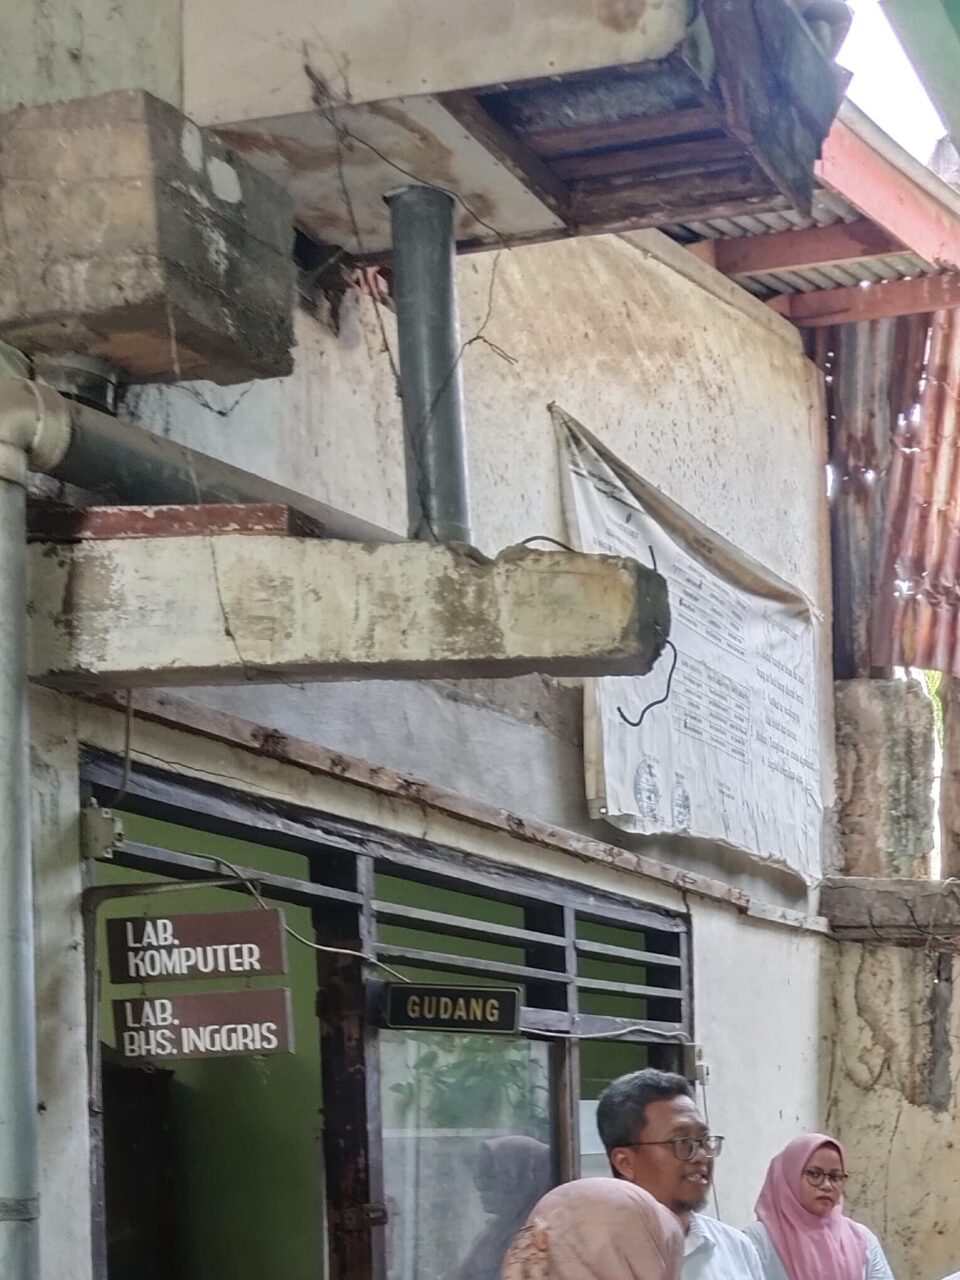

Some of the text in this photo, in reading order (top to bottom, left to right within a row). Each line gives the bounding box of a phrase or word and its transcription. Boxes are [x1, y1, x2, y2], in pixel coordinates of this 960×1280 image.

[126, 919, 180, 948] LAB.
[127, 943, 261, 977] KOMPUTER
[125, 999, 180, 1027] LAB.
[406, 995, 500, 1022] GUDANG
[123, 1022, 278, 1057] BHS. INGGRIS
